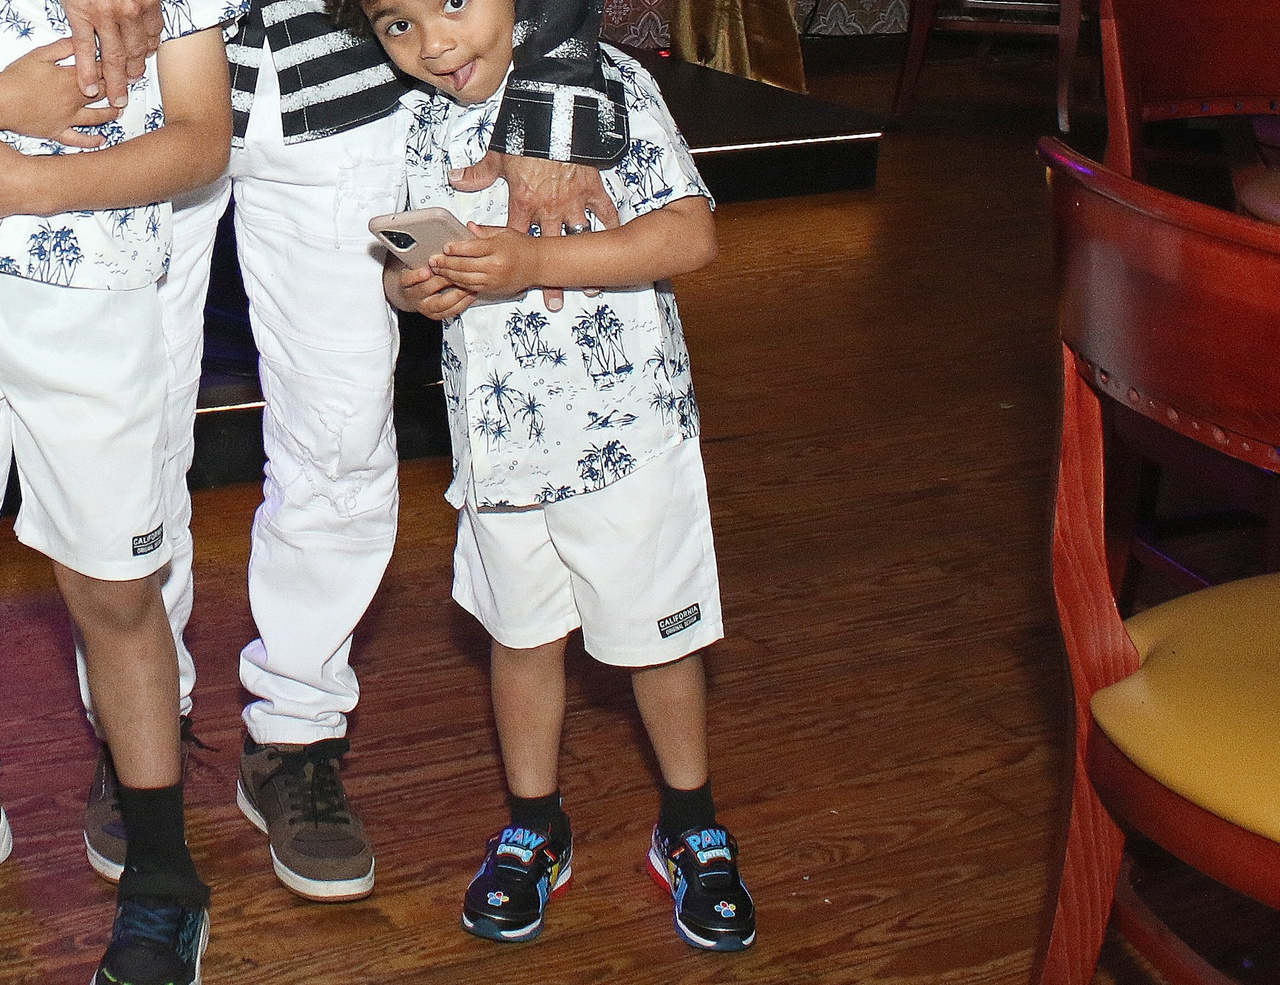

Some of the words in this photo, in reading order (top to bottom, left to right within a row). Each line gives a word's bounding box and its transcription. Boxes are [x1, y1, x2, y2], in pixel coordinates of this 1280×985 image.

[659, 606, 699, 628] CALIFORNIA
[500, 828, 545, 850] PAW
[686, 829, 726, 852] PAW
